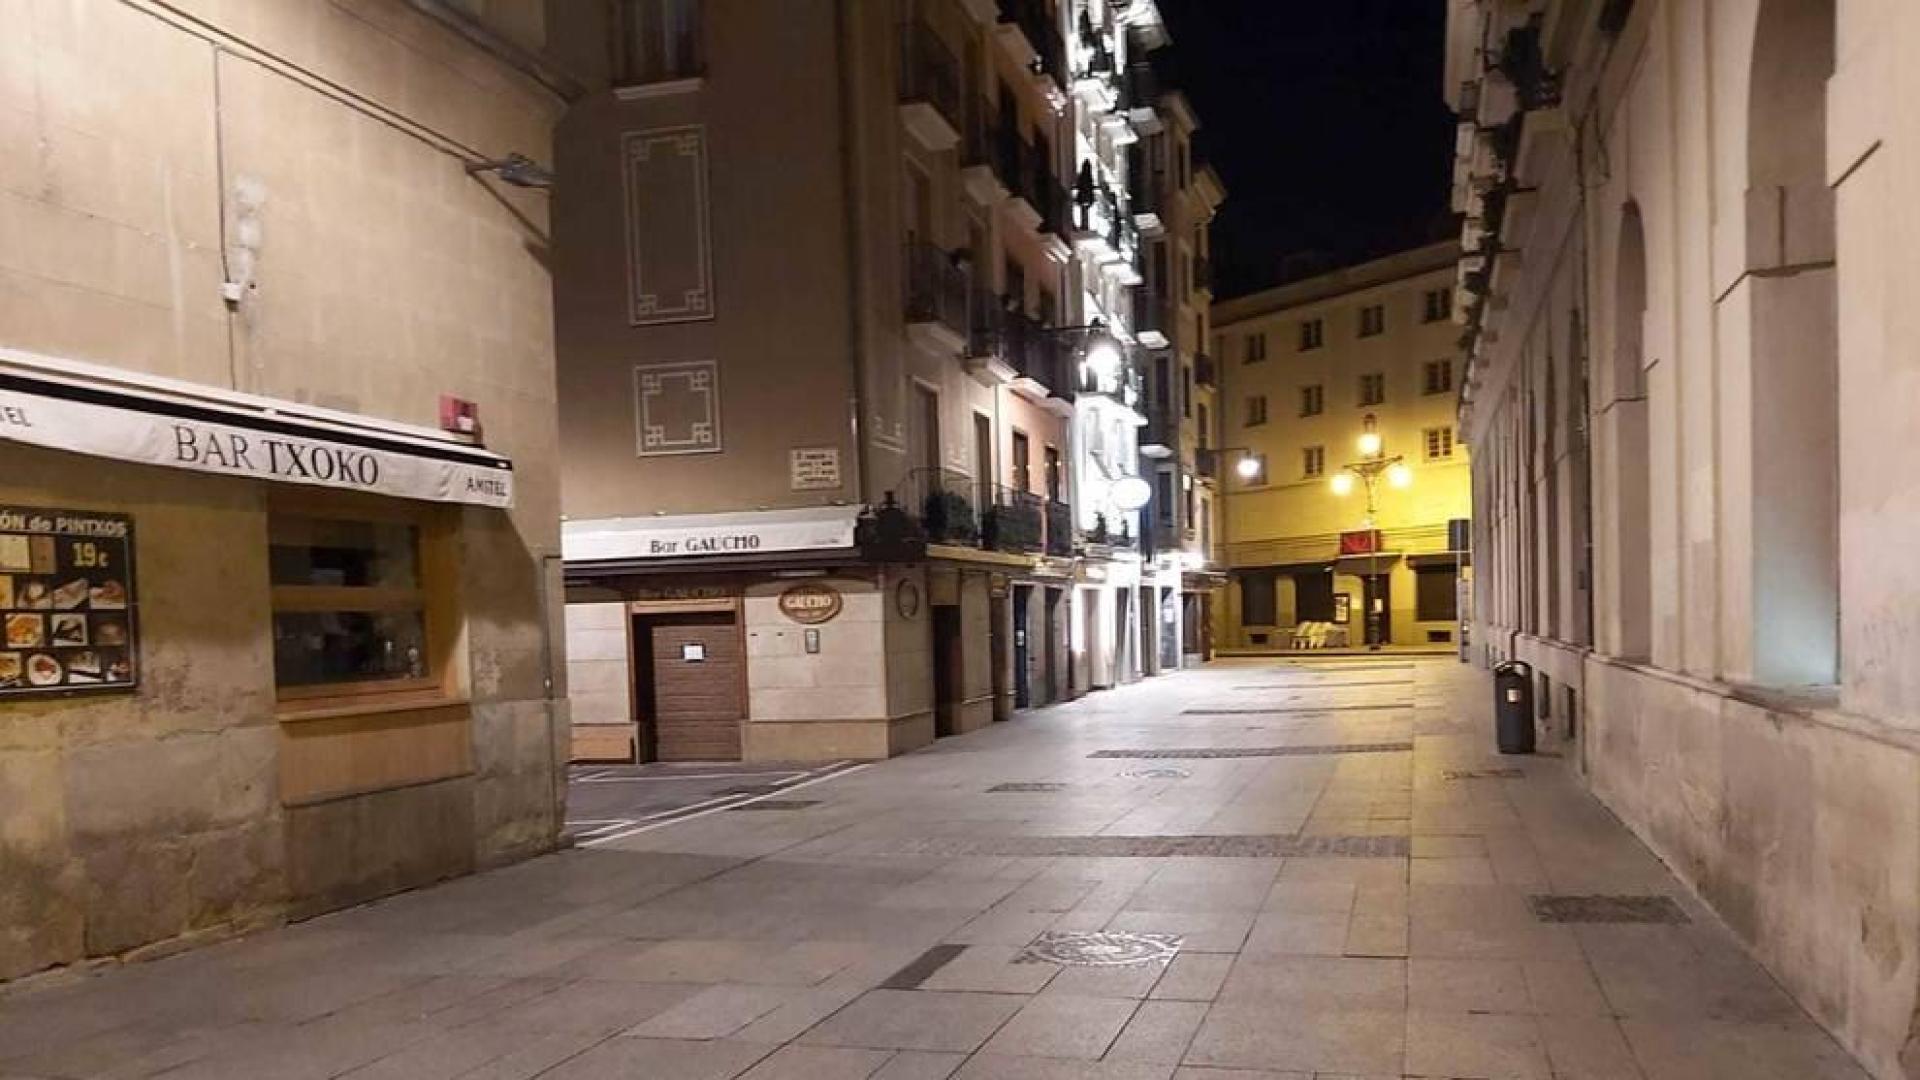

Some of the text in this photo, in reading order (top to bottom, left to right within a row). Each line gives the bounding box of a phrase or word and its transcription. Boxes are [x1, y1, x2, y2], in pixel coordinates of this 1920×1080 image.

[173, 424, 380, 486] BAR TXOKO
[56, 516, 127, 537] PINTXOS
[650, 534, 761, 554] Bar GAUCHO
